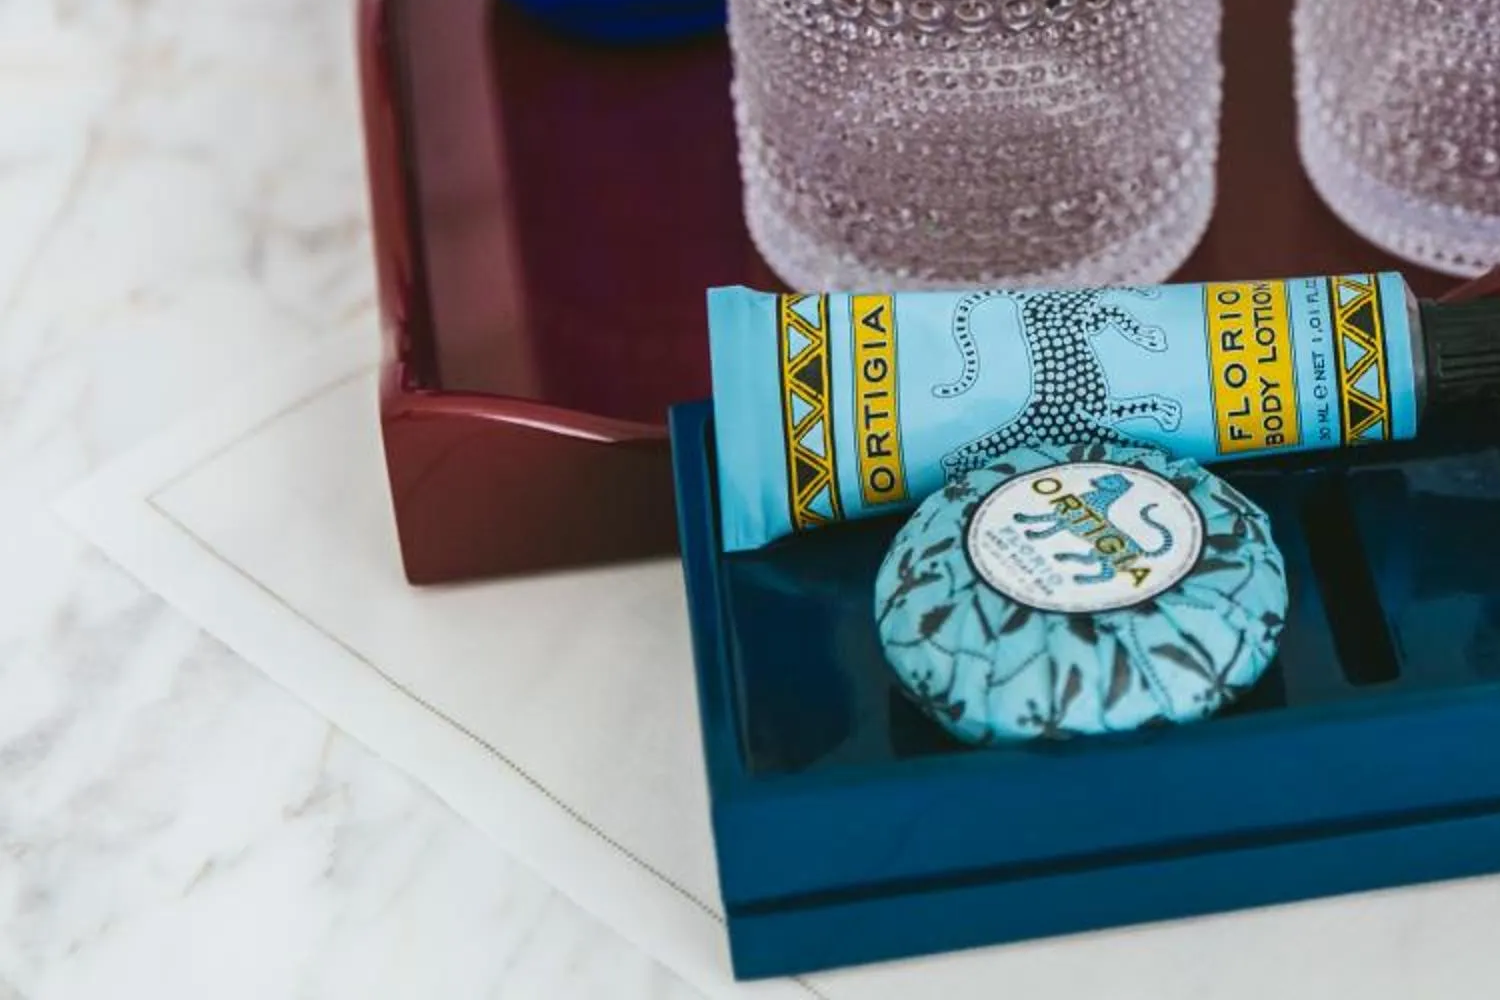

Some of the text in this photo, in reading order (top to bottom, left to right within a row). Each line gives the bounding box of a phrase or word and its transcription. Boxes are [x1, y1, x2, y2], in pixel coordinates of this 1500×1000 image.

[861, 304, 896, 493] ORTIGIA
[1217, 289, 1253, 441] FLORIO
[1251, 280, 1285, 446] BODY LOTION
[1312, 352, 1328, 381] NET
[1031, 476, 1152, 588] ORTIGIA
